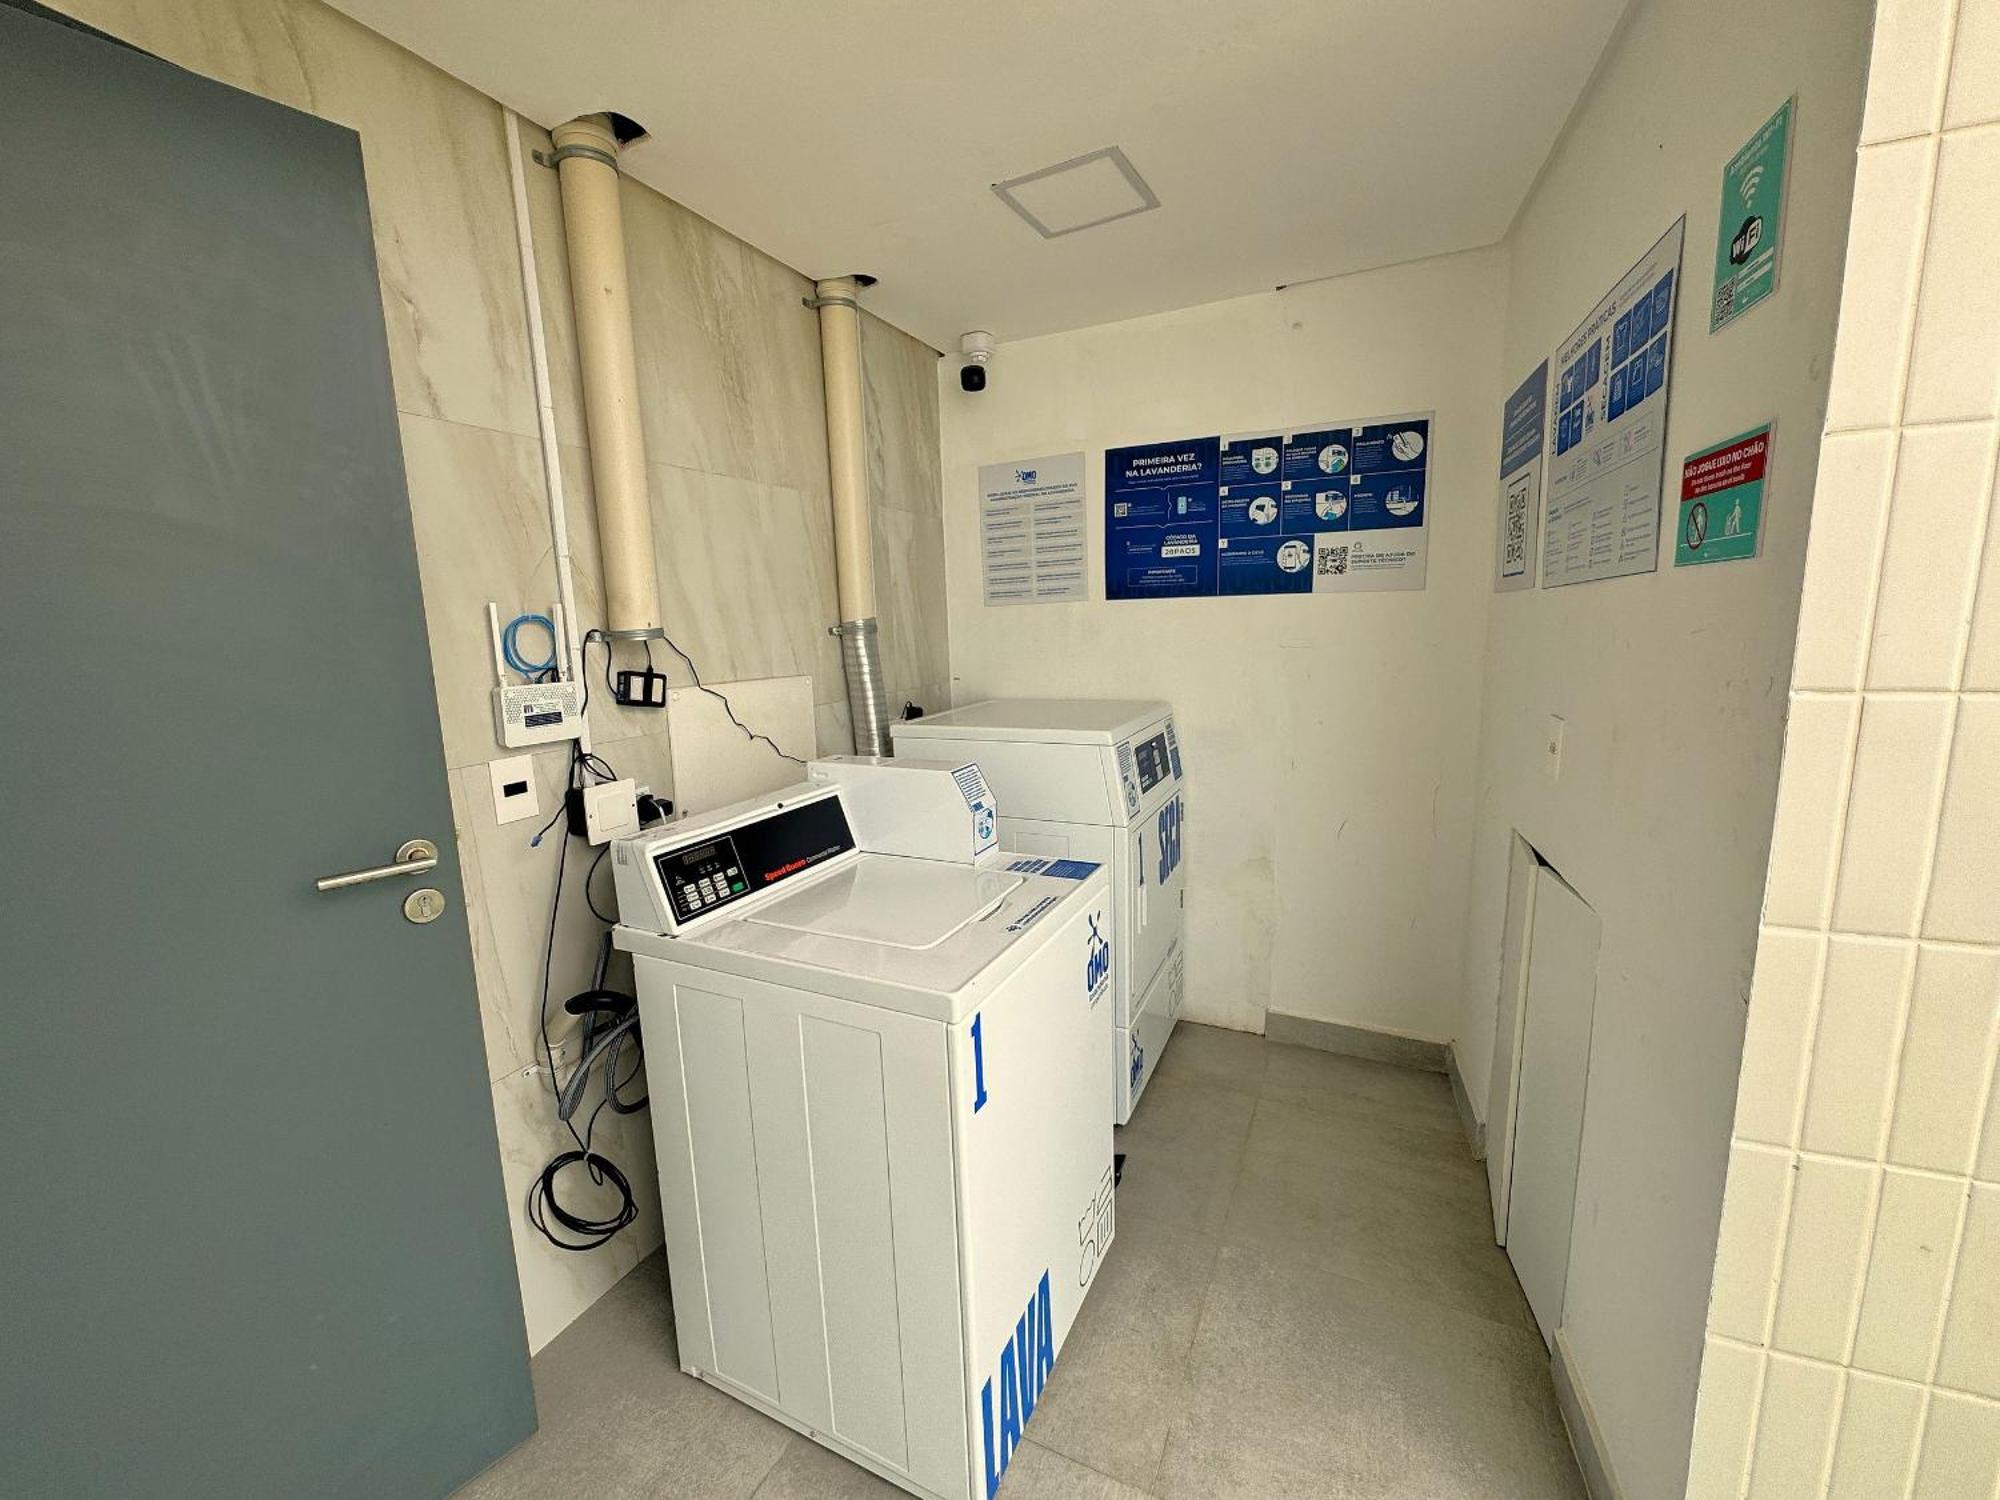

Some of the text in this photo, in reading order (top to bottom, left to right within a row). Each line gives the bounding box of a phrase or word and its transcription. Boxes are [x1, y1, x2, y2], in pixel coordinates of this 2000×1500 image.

[1133, 453, 1196, 467] PRIMEIRA VEZ
[1731, 449, 1742, 462] NO
[1743, 440, 1765, 458] CHÃO
[1125, 462, 1202, 478] NA LAVANDERIA?
[970, 1012, 988, 1114] 1
[981, 1268, 1054, 1500] LAVA
